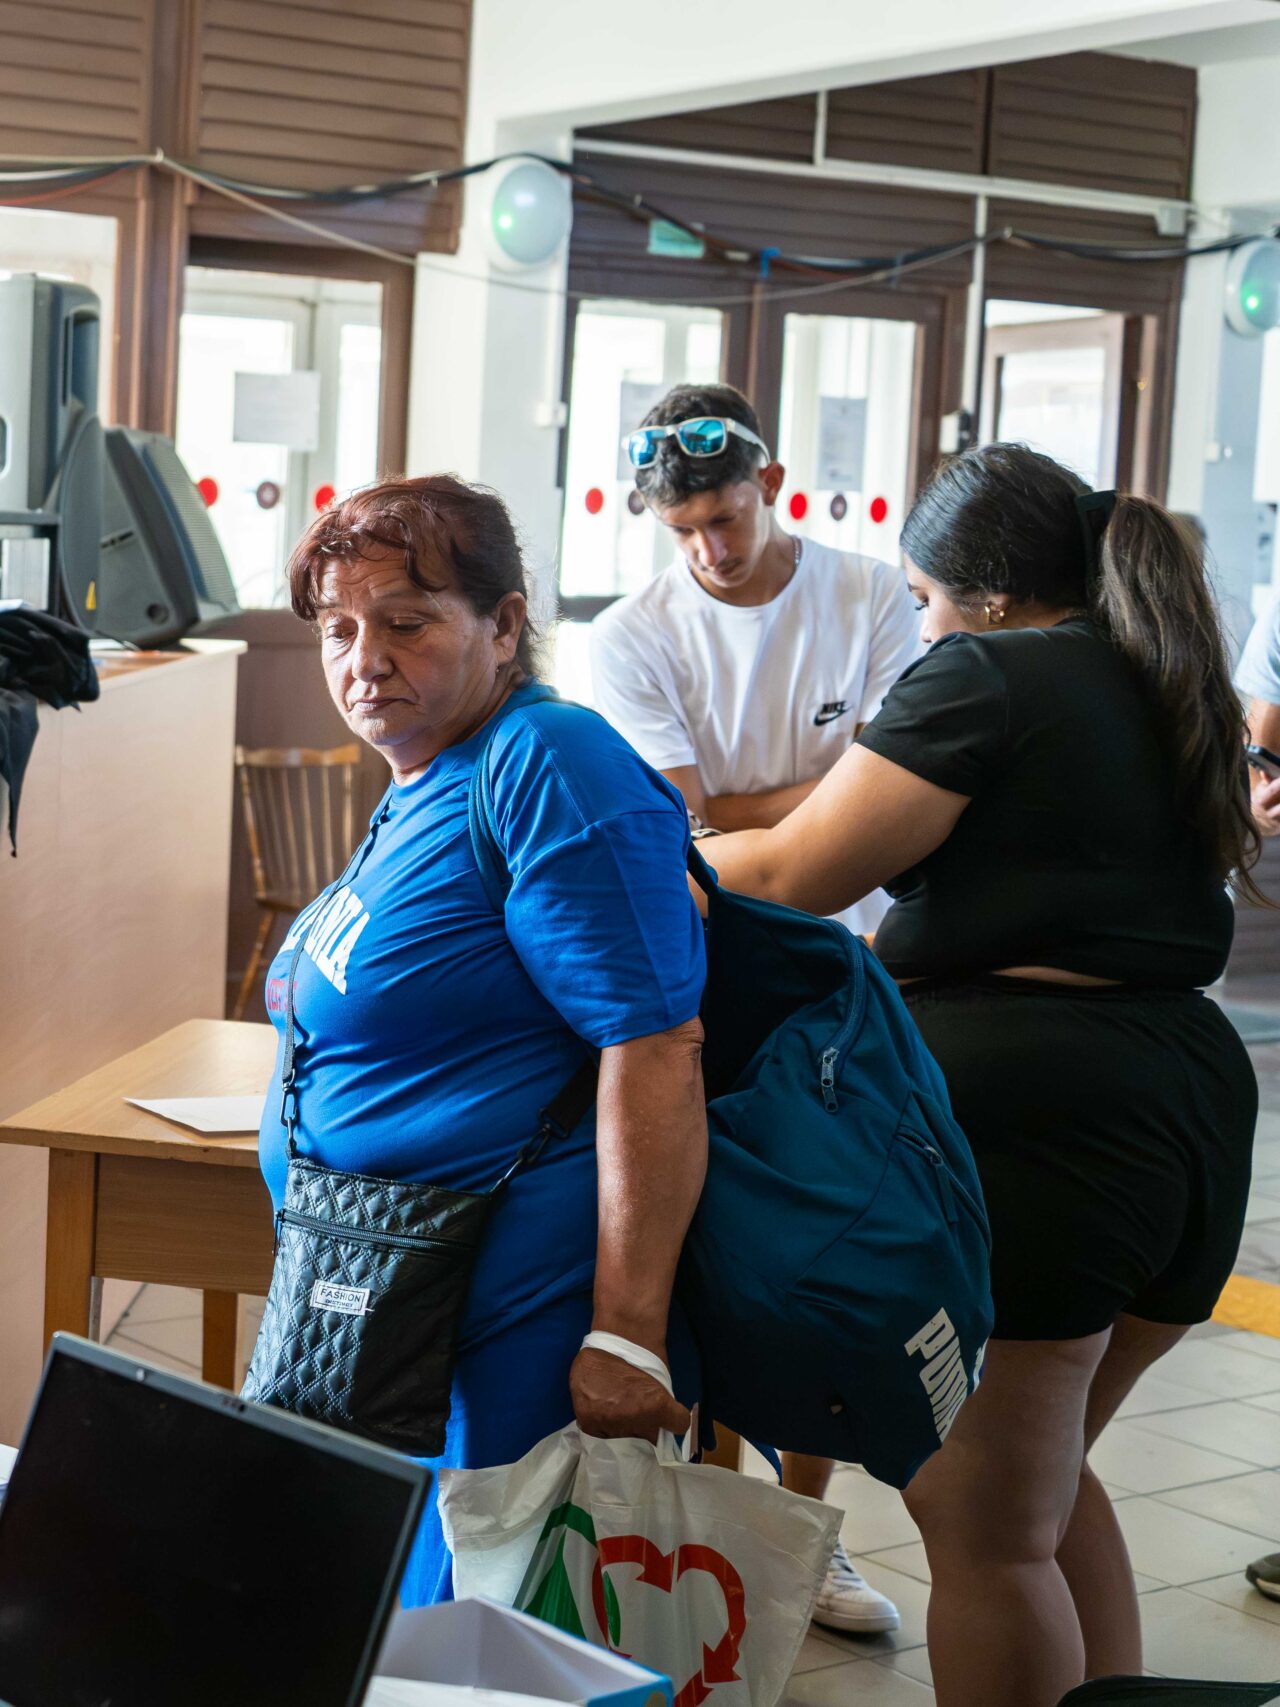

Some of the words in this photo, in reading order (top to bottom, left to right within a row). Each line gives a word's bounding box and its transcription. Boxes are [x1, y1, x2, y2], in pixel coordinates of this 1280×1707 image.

[820, 700, 847, 714] NIKE
[320, 1288, 361, 1303] FASHION
[904, 1307, 968, 1443] PUMA
